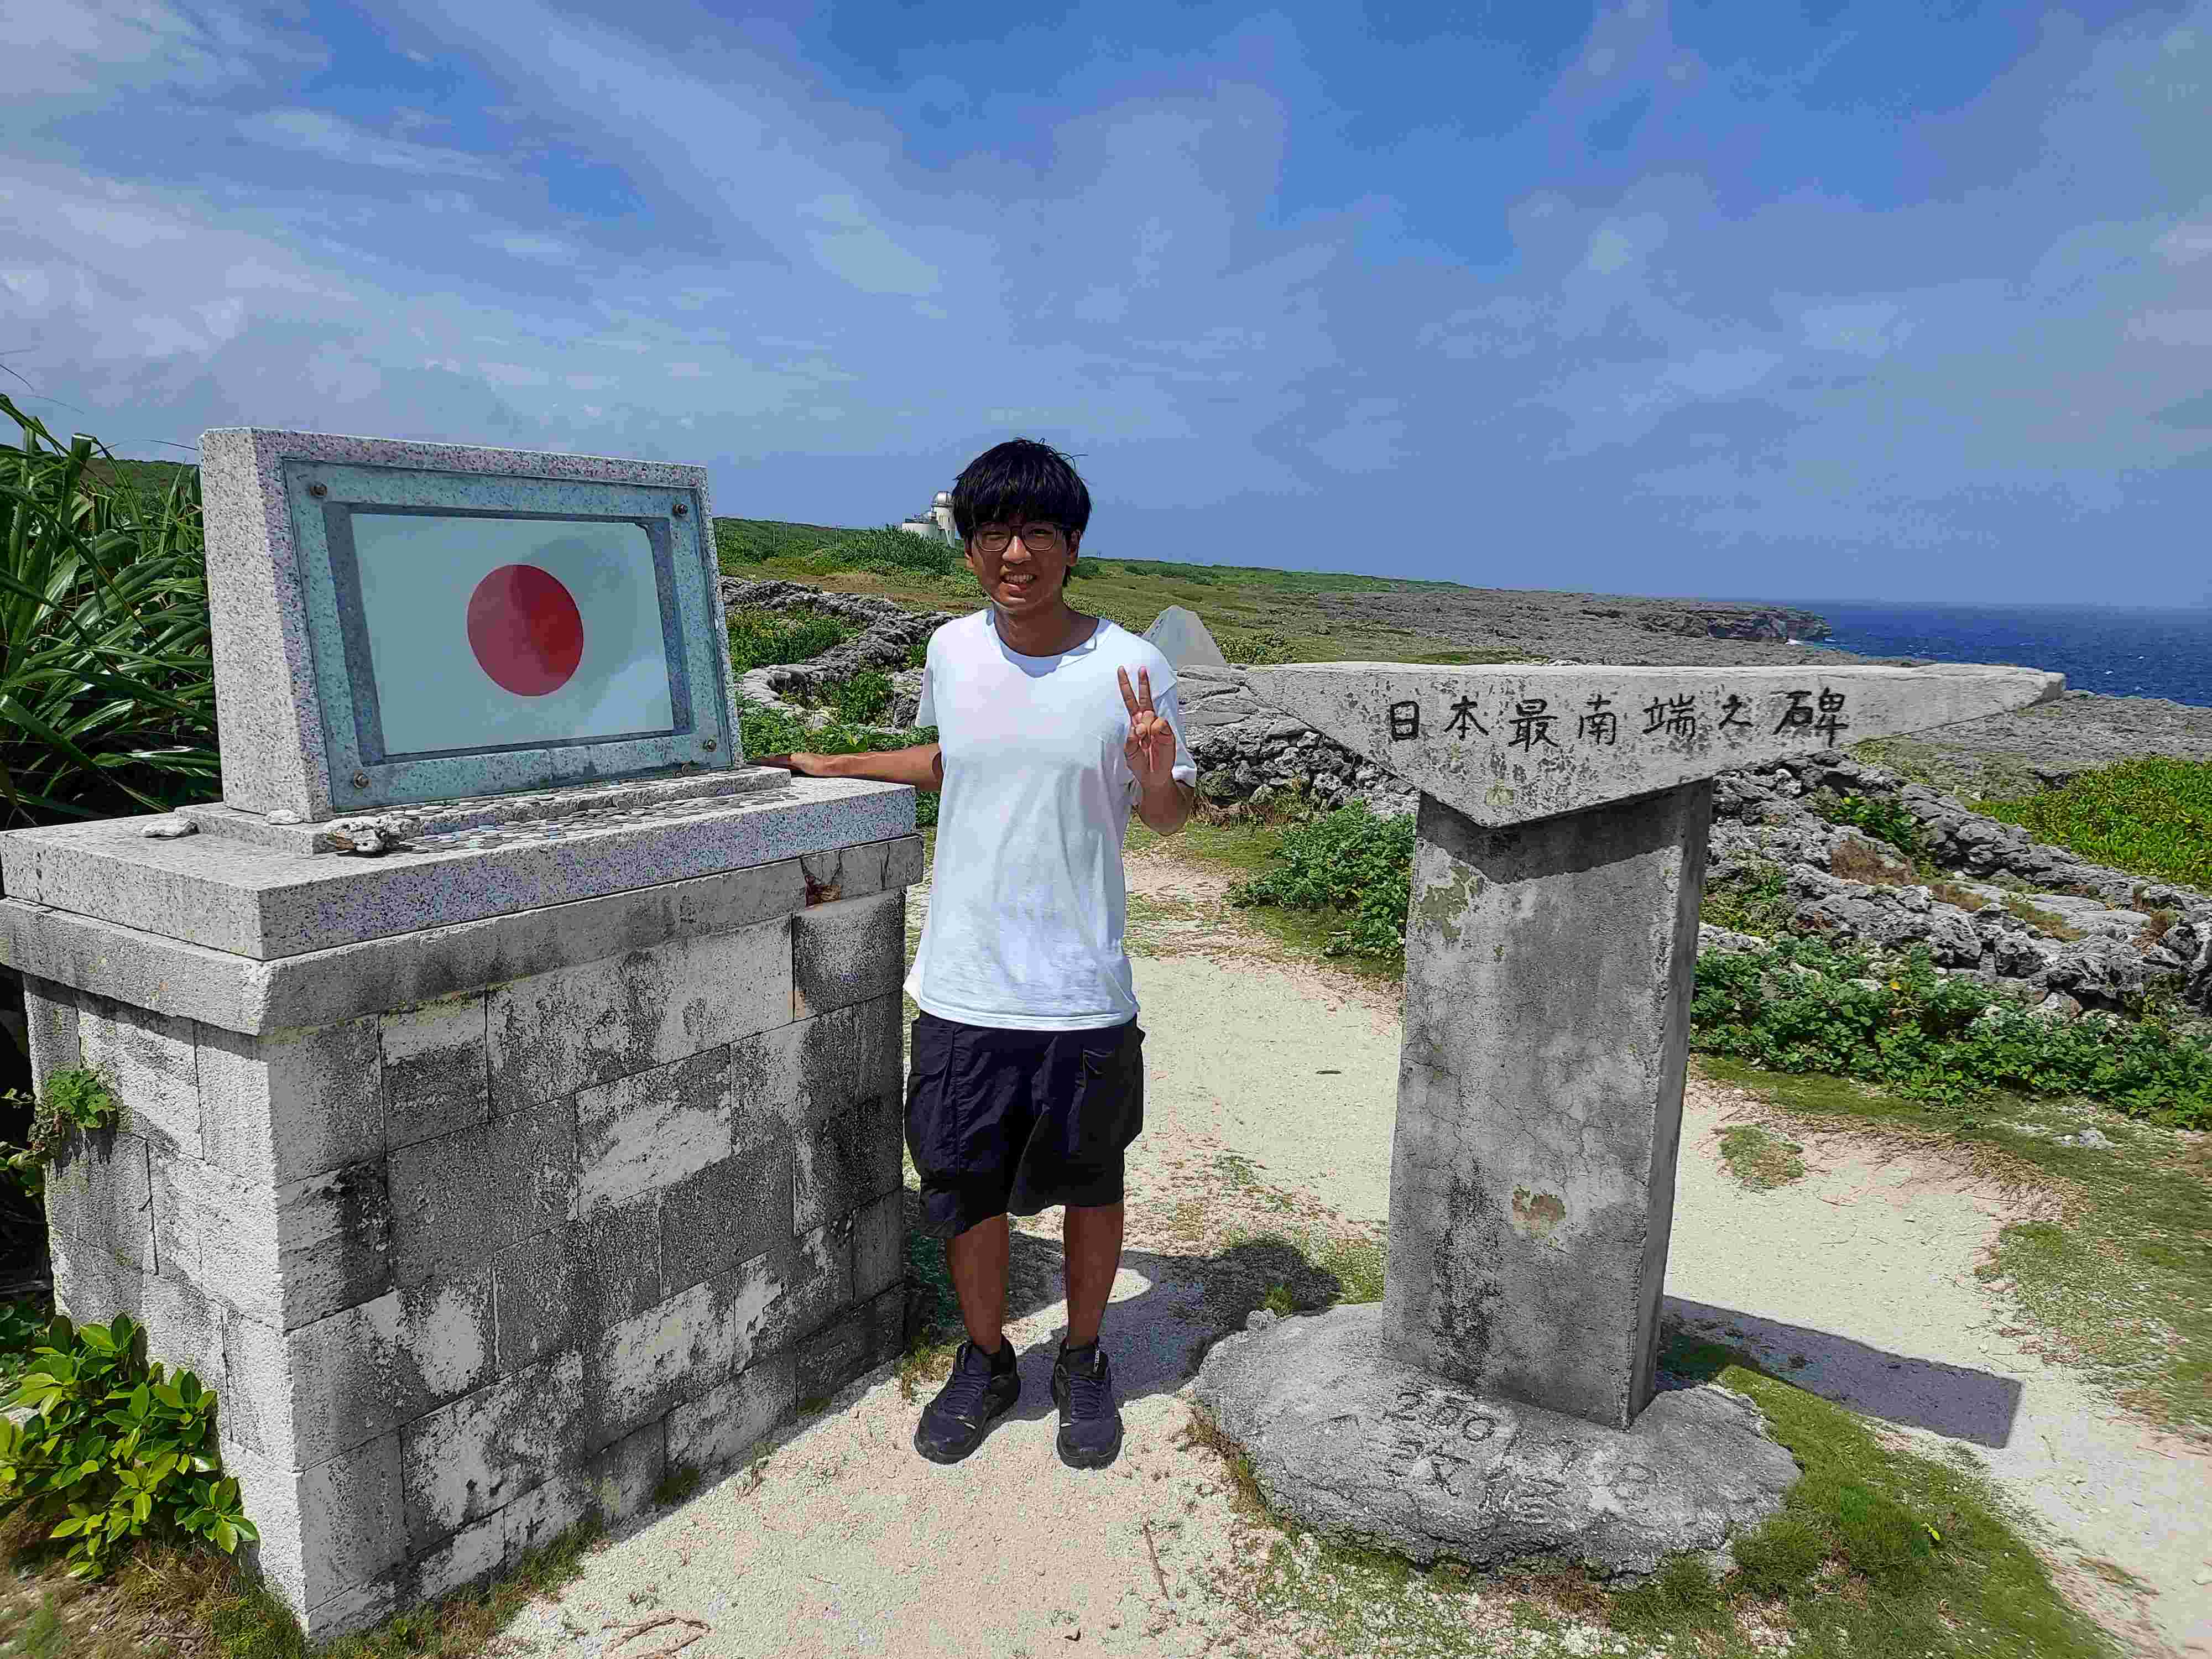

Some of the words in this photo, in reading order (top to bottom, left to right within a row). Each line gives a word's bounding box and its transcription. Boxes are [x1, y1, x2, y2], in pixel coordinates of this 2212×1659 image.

[1388, 686, 1849, 752] 日本最南端之碑
